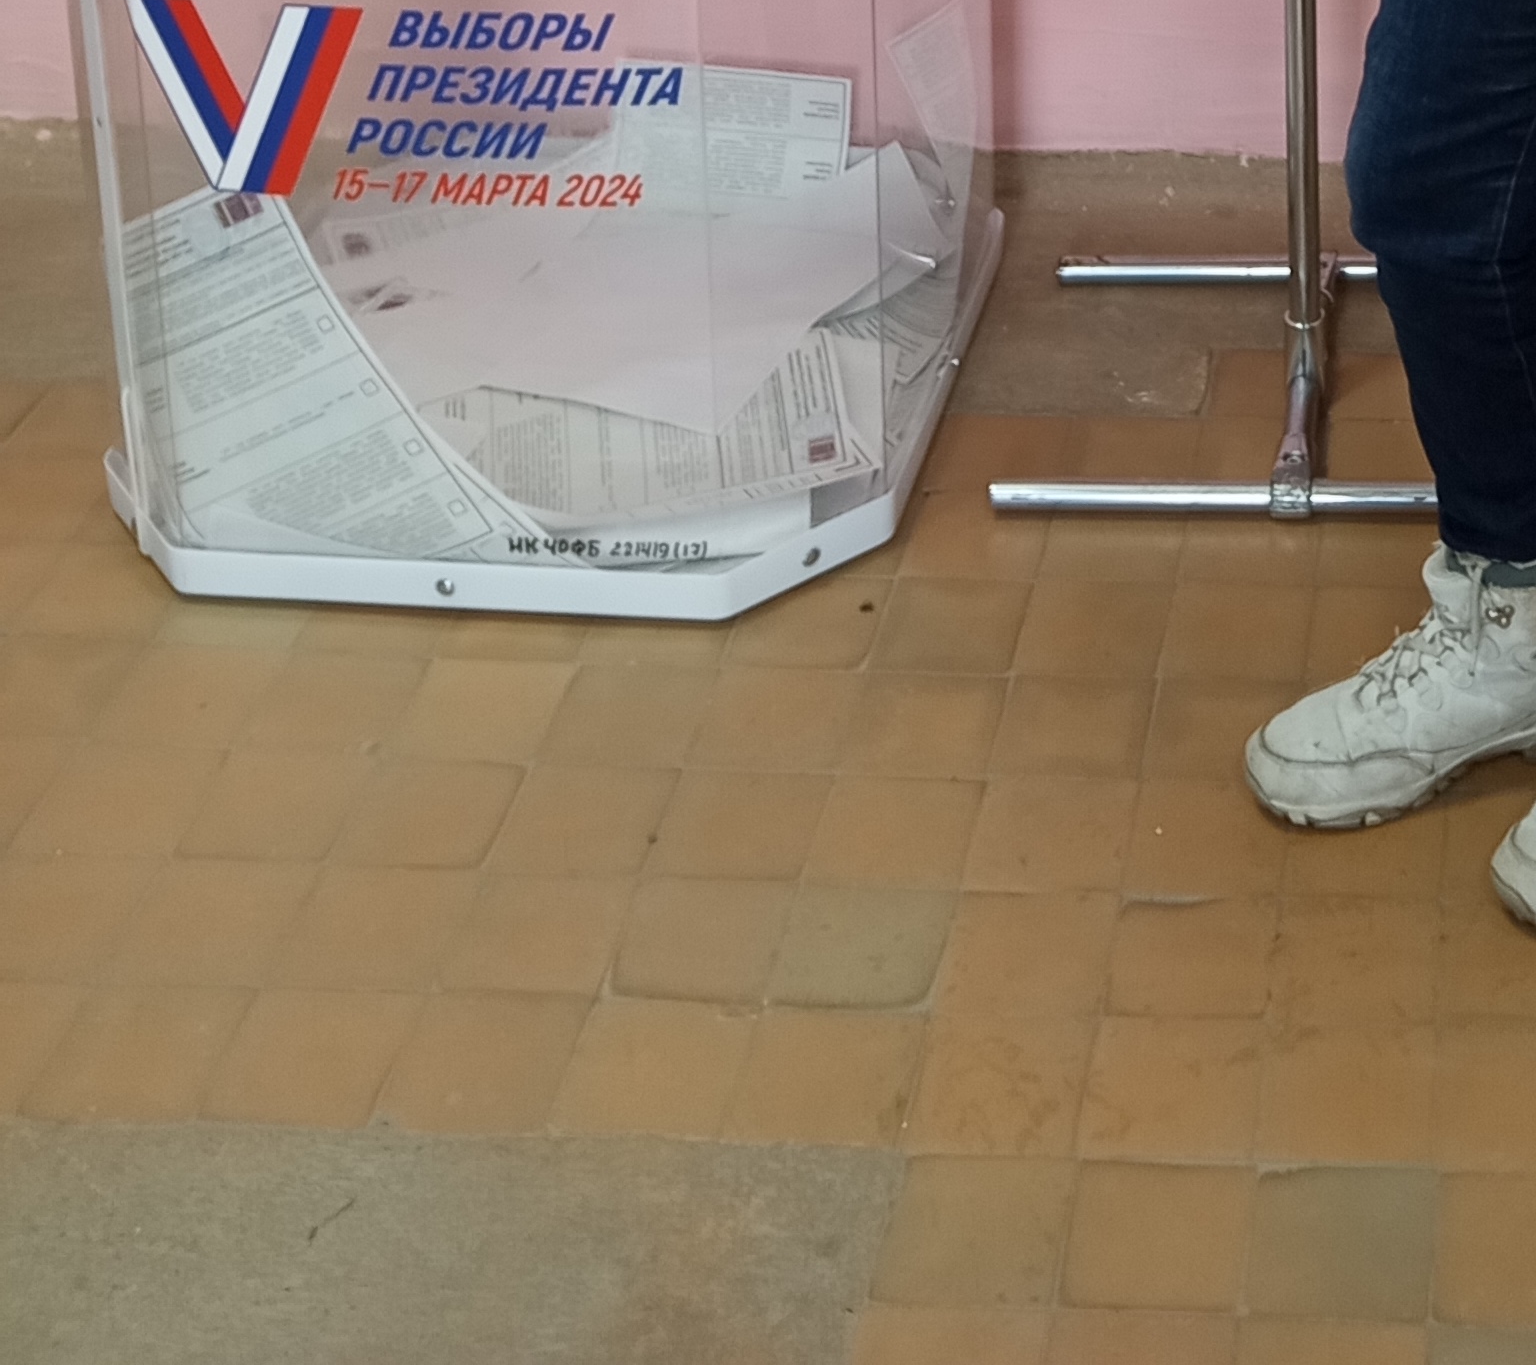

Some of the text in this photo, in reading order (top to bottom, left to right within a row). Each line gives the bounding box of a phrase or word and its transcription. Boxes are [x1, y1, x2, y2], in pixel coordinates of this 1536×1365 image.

[387, 9, 615, 52] ВЫБОРЫ
[367, 64, 683, 112] ПРЕЗИДЕНТА
[345, 117, 551, 159] РОССИИ
[333, 168, 643, 208] 15–17 МАРТА 2024
